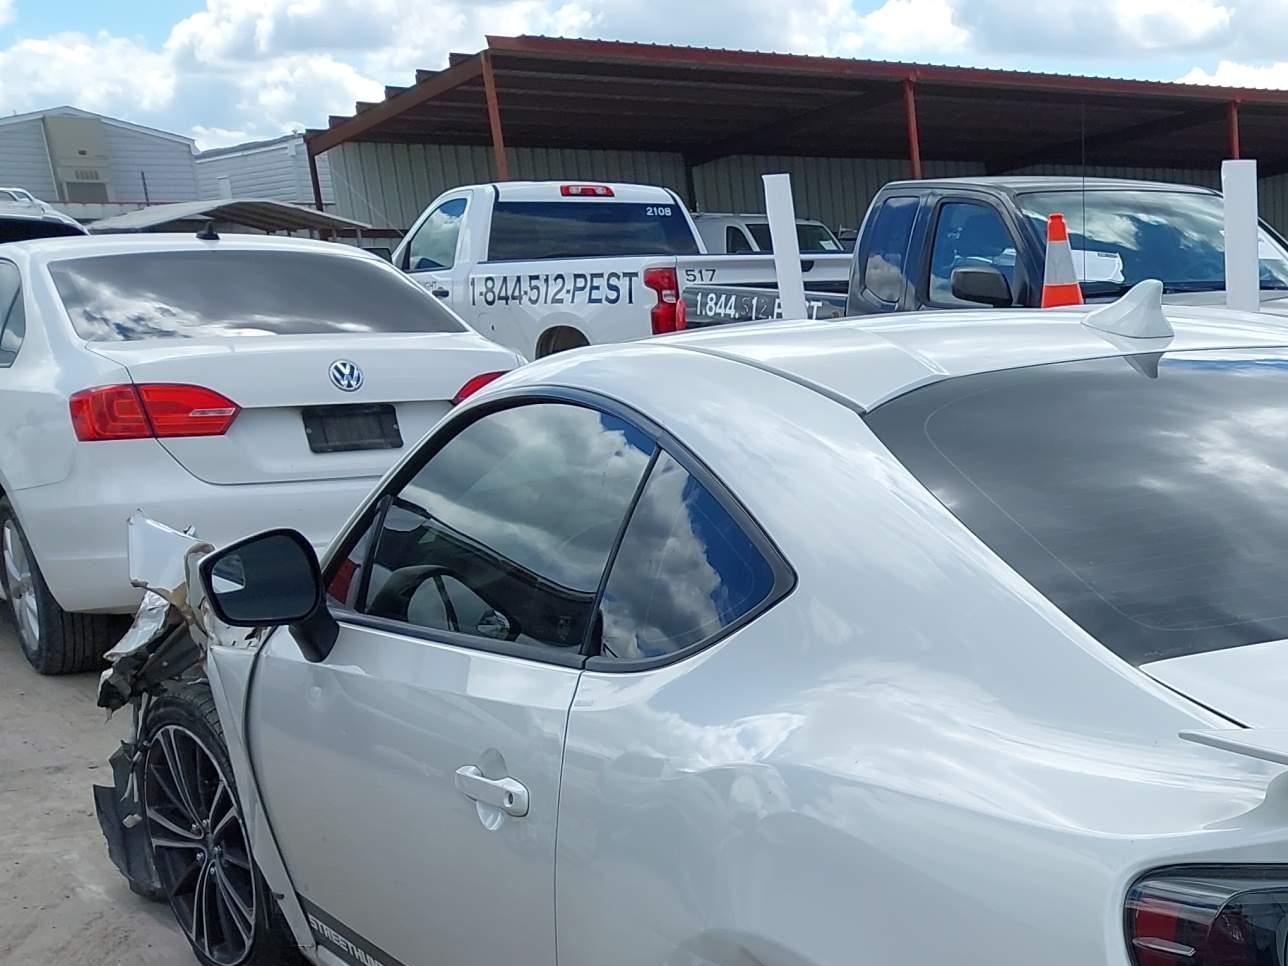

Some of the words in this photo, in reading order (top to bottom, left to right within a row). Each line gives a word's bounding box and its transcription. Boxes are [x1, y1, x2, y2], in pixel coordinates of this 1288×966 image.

[646, 206, 672, 216] 2108
[684, 268, 716, 282] 517
[470, 271, 639, 306] 1-844-512-PEST
